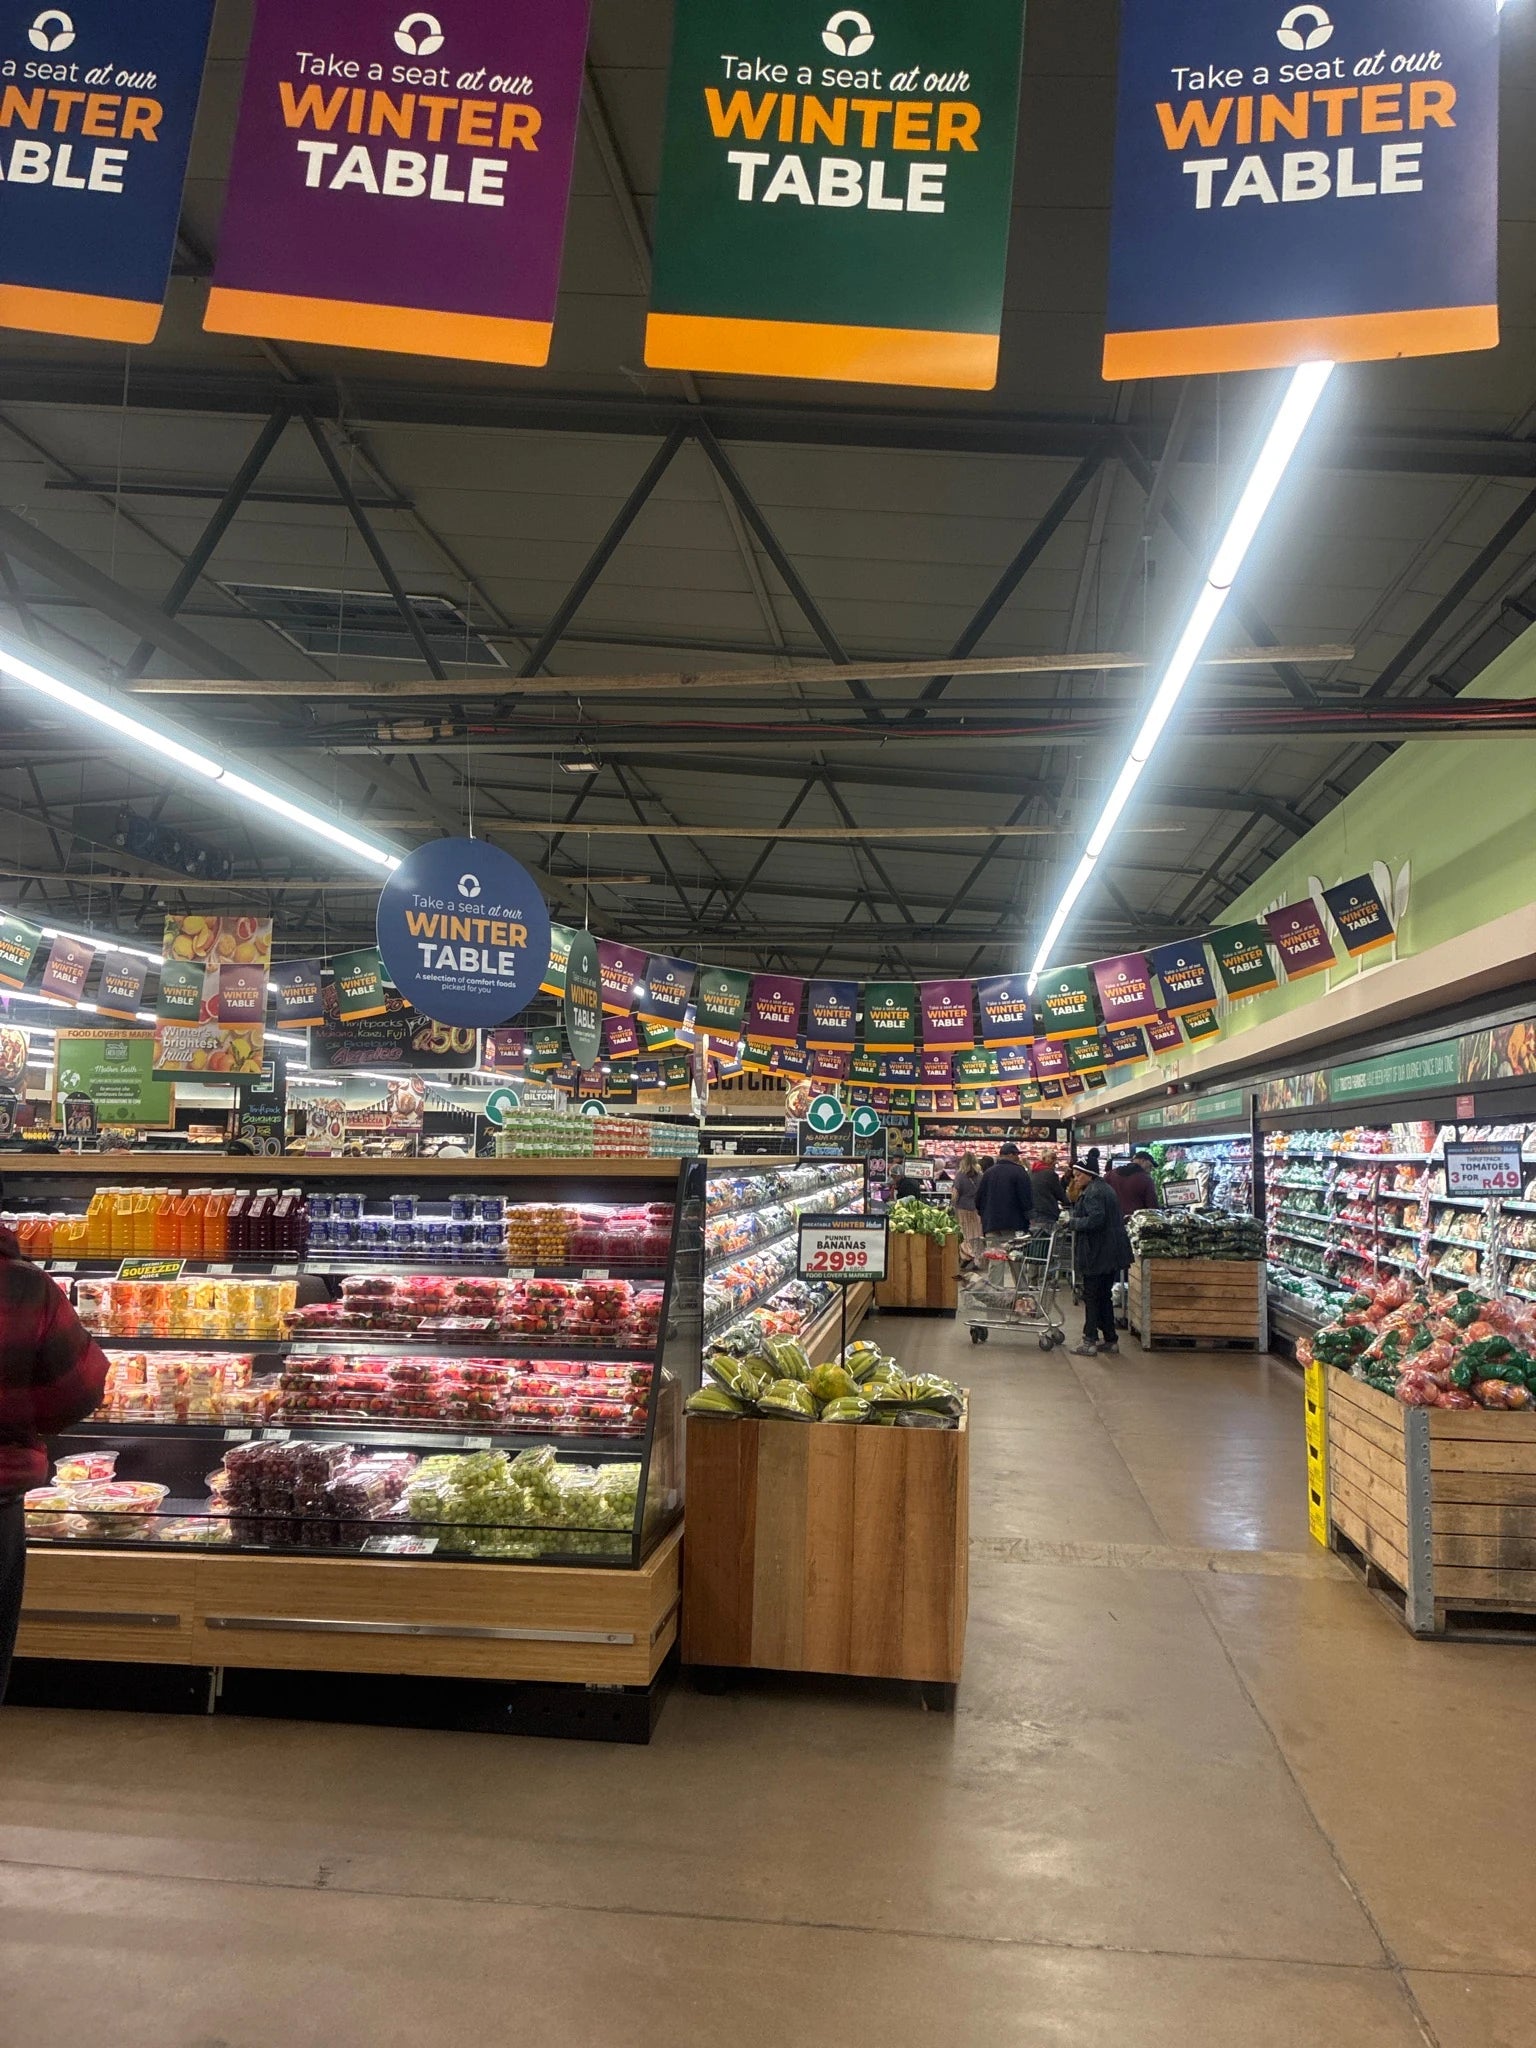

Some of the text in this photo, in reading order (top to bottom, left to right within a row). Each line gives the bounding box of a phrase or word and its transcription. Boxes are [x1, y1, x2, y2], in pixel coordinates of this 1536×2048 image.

[1, 59, 158, 90] a seat at our
[296, 51, 534, 96] Take a seat at our
[720, 54, 971, 93] Take a seat at our
[1170, 48, 1442, 92] Take a seat at our
[278, 81, 542, 152] WINTER
[704, 87, 981, 152] WINTER
[1155, 79, 1457, 151] WINTER
[0, 139, 129, 193] BLE
[297, 139, 508, 207] TABLE
[1182, 142, 1423, 210] TABLE
[727, 150, 947, 214] TABLE
[412, 894, 523, 919] Take a seat at our
[1339, 904, 1380, 924] WINTER
[1346, 912, 1380, 932] TABLE
[405, 910, 528, 949] WINTER
[1280, 928, 1320, 948] WINTER
[1287, 938, 1320, 954] TABLE
[417, 942, 515, 976] TABLE
[1222, 949, 1264, 968] WINTER
[51, 961, 84, 977] WINTER
[1229, 958, 1263, 974] TABLE
[52, 970, 78, 984] TABLE
[340, 976, 377, 989] WINTER
[422, 973, 457, 983] selection
[466, 976, 496, 987] comfort
[496, 979, 516, 989] foods
[1164, 968, 1205, 984] WINTER
[105, 976, 140, 990] WINTER
[441, 982, 465, 991] picked
[466, 984, 477, 993] for
[650, 982, 686, 997] WINTER
[1170, 978, 1204, 992] TABLE
[107, 985, 134, 997] TABLE
[163, 986, 198, 998] WINTER
[224, 990, 259, 1000] WINTER
[280, 986, 318, 997] WINTER
[344, 984, 376, 997] TABLE
[570, 984, 598, 1008] WINTER
[1104, 982, 1146, 998] WINTER
[166, 996, 194, 1006] TABLE
[226, 999, 255, 1008] TABLE
[284, 996, 314, 1005] TABLE
[651, 992, 680, 1005] TABLE
[704, 994, 741, 1007] WINTER
[1046, 995, 1088, 1008] WINTER
[1110, 992, 1144, 1006] TABLE
[706, 1004, 735, 1016] TABLE
[756, 1002, 795, 1014] WINTER
[812, 1008, 852, 1018] WINTER
[927, 1010, 968, 1018] WINTER
[985, 1004, 1026, 1015] WINTER
[1051, 1004, 1086, 1016] TABLE
[574, 1008, 596, 1030] TABLE
[759, 1012, 790, 1022] TABLE
[816, 1017, 847, 1026] TABLE
[870, 1010, 910, 1020] WINTER
[990, 1013, 1024, 1023] TABLE
[874, 1020, 905, 1028] TABLE
[932, 1018, 964, 1028] TABLE
[1190, 1018, 1210, 1028] TABLE
[68, 1030, 128, 1038] FOOD LOVER'S
[650, 1026, 669, 1036] TABLE
[1154, 1030, 1175, 1040] TABLE
[163, 1036, 218, 1050] brightest
[612, 1037, 632, 1045] TABLE
[715, 1037, 734, 1047] TABLE
[1116, 1042, 1137, 1050] TABLE
[159, 1048, 194, 1066] fruits
[749, 1048, 768, 1056] TABLE
[1078, 1052, 1099, 1060] TABLE
[784, 1056, 804, 1064] TABLE
[819, 1062, 838, 1070] TABLE
[1460, 1163, 1510, 1171] TOMATOES
[1450, 1172, 1460, 1183] 3
[1482, 1171, 1519, 1188] R49
[817, 1241, 866, 1250] BANANAS
[122, 1264, 180, 1277] SQUEEZED
